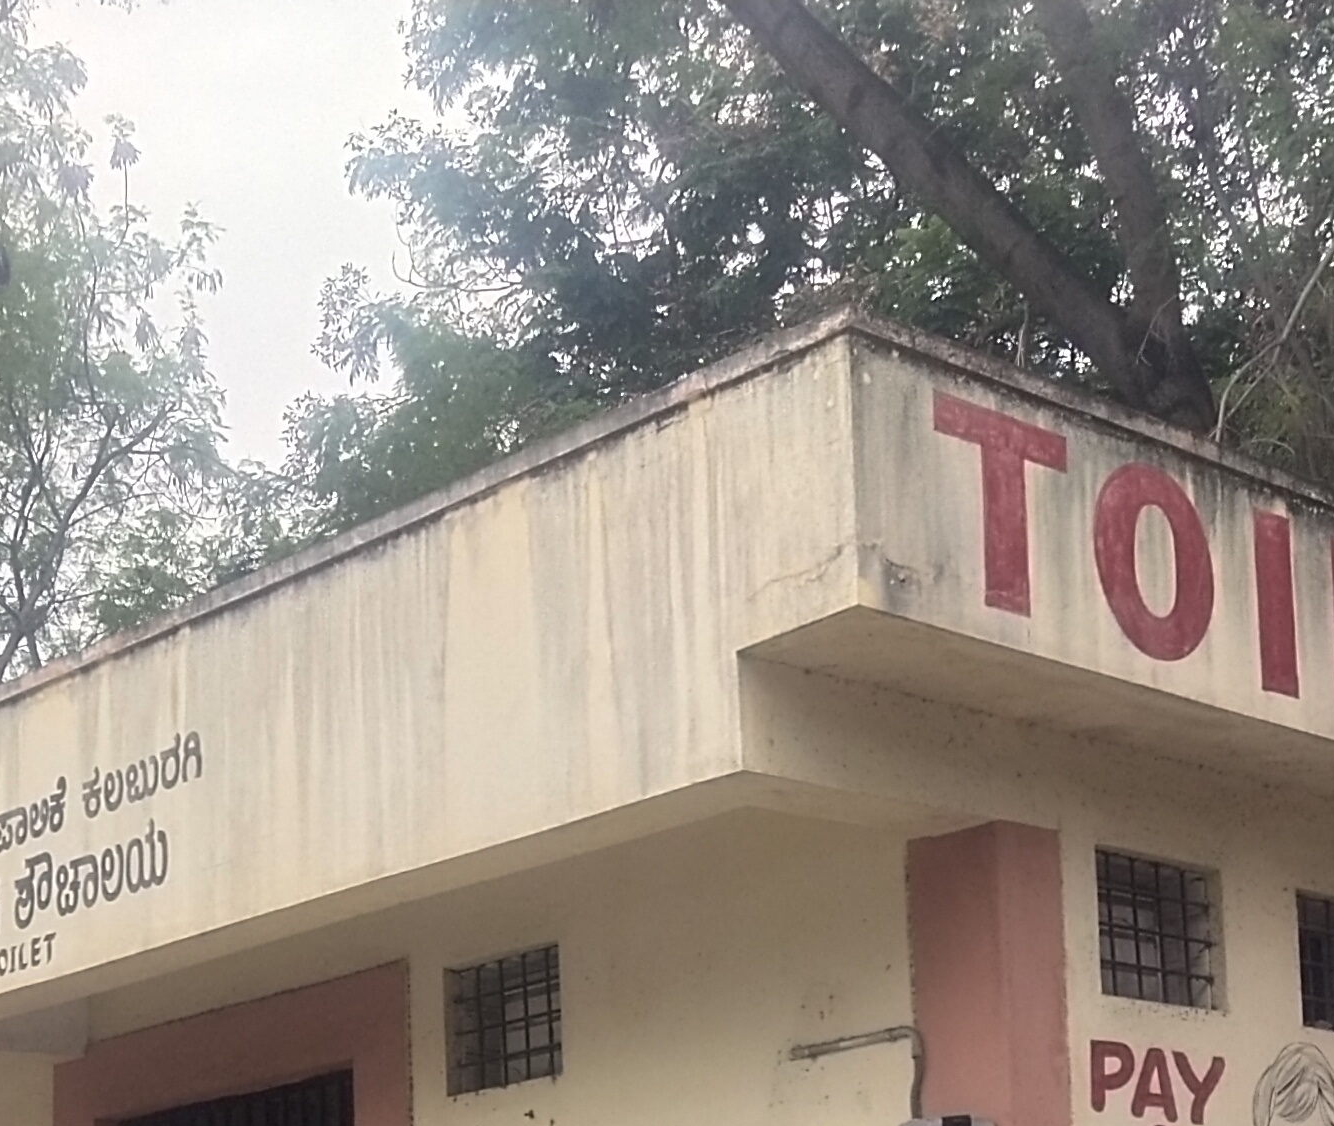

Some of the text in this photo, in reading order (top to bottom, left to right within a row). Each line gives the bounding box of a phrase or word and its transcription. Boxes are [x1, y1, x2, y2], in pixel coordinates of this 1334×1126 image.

[82, 731, 203, 819] ಕಲಬುರಗಿ
[14, 818, 169, 930] ಶೌಚಾಲಯ
[1089, 1039, 1226, 1126] PAY
